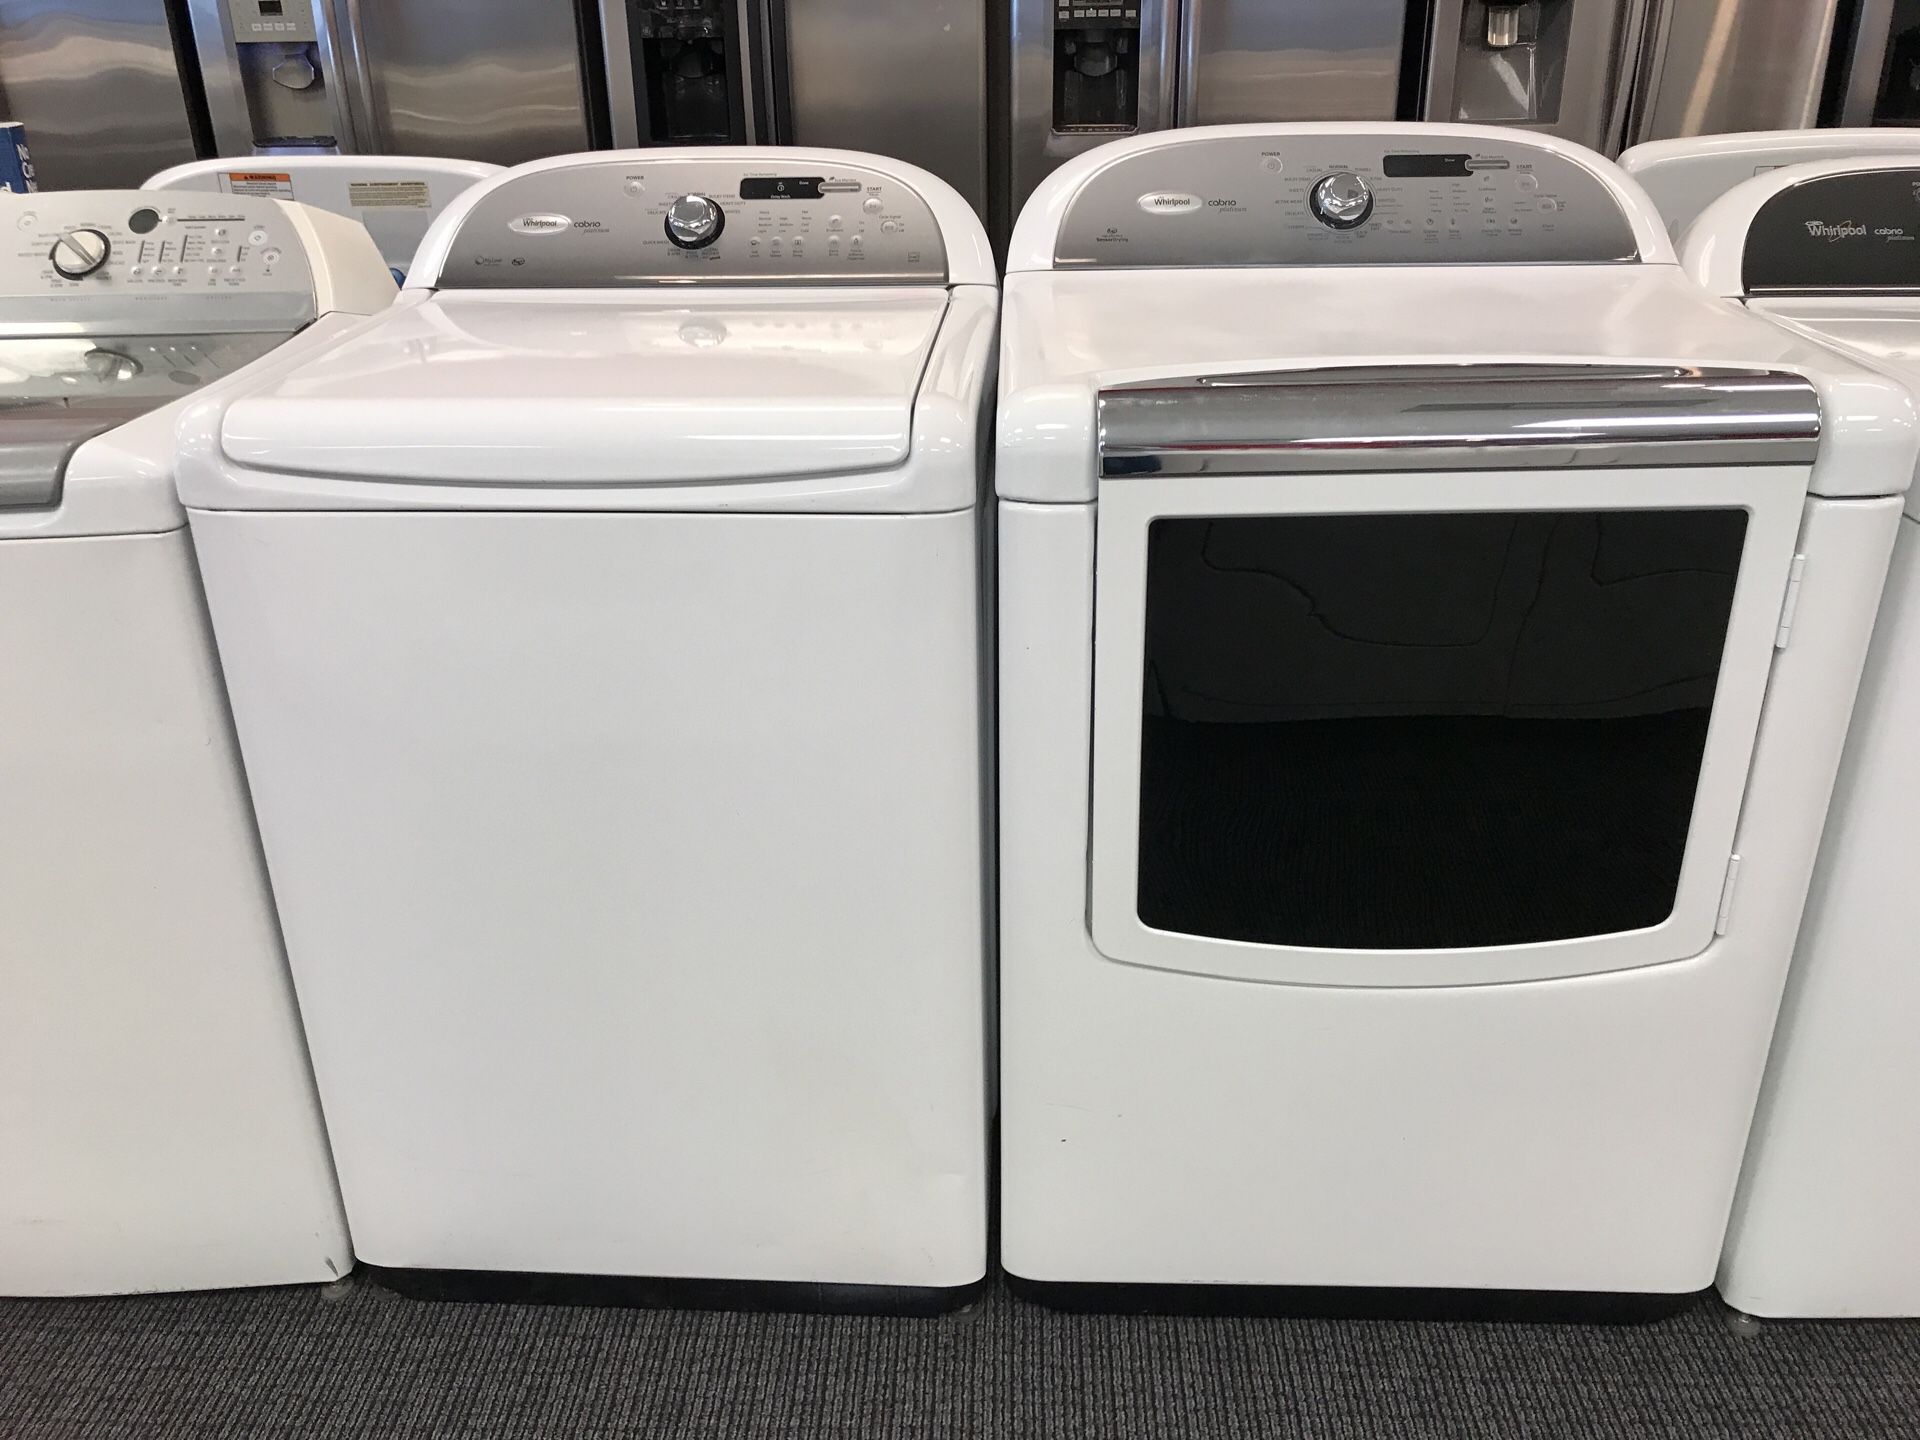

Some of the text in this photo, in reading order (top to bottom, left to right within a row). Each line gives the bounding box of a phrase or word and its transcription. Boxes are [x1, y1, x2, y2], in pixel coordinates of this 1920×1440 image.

[1154, 197, 1236, 207] Whirlpool cabrio
[522, 218, 557, 228] Whirlpool
[1806, 223, 1904, 239] Whirlpool cabrio
